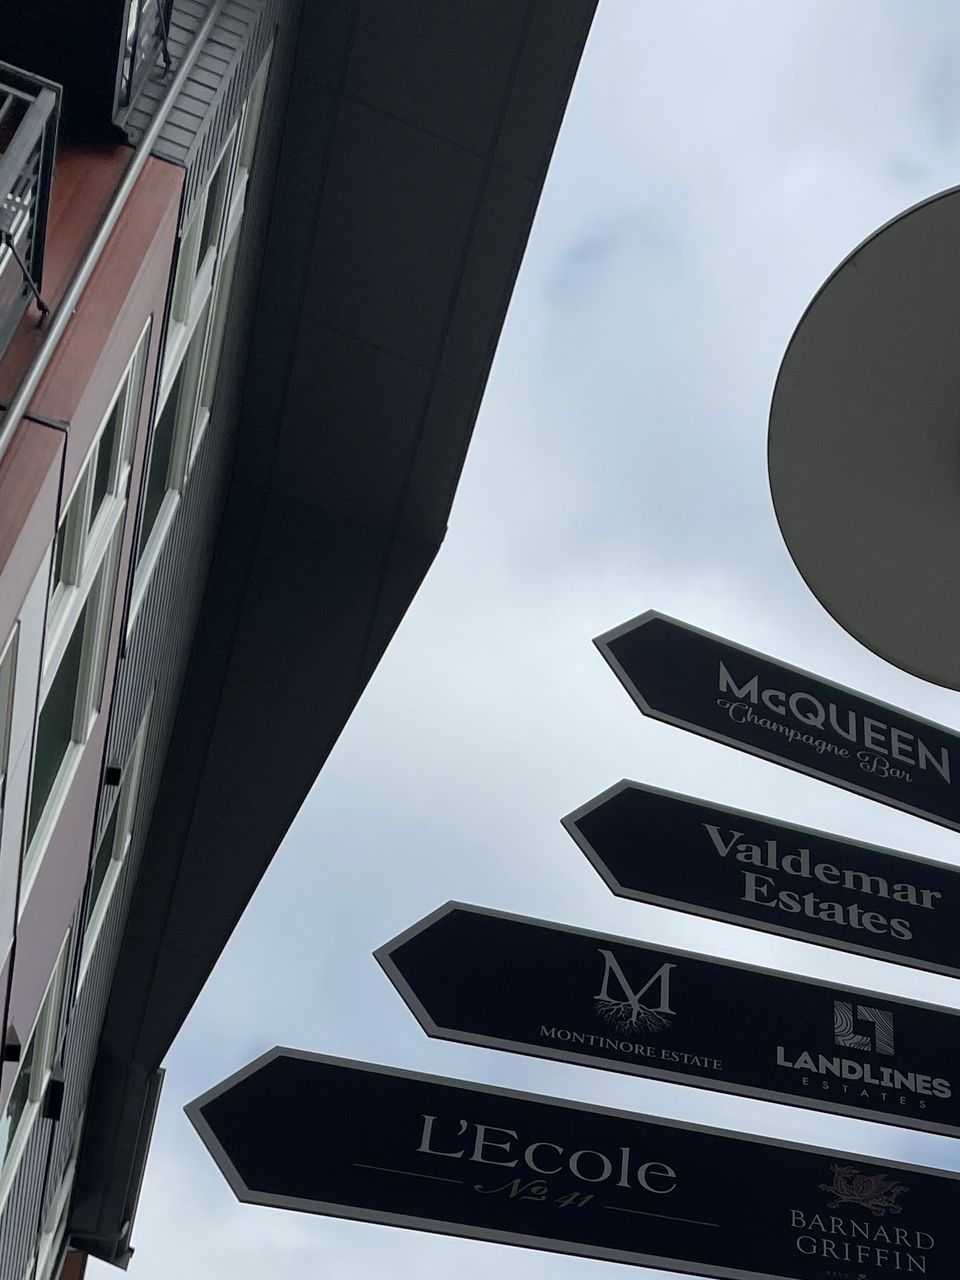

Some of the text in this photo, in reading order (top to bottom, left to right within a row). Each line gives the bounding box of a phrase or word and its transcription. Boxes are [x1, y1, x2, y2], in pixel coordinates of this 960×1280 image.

[716, 698, 913, 783] Champagne Bar
[718, 659, 952, 785] McQUEEN
[701, 822, 942, 910] Valdemar
[740, 870, 913, 941] Estates
[539, 1024, 723, 1071] MONTINORE ESTATE
[776, 1045, 952, 1099] LANDLINES
[802, 1076, 927, 1110] ESTATES
[554, 1191, 595, 1209] 41
[790, 1208, 935, 1251] BARNARD
[796, 1235, 927, 1274] GRIFFIN
